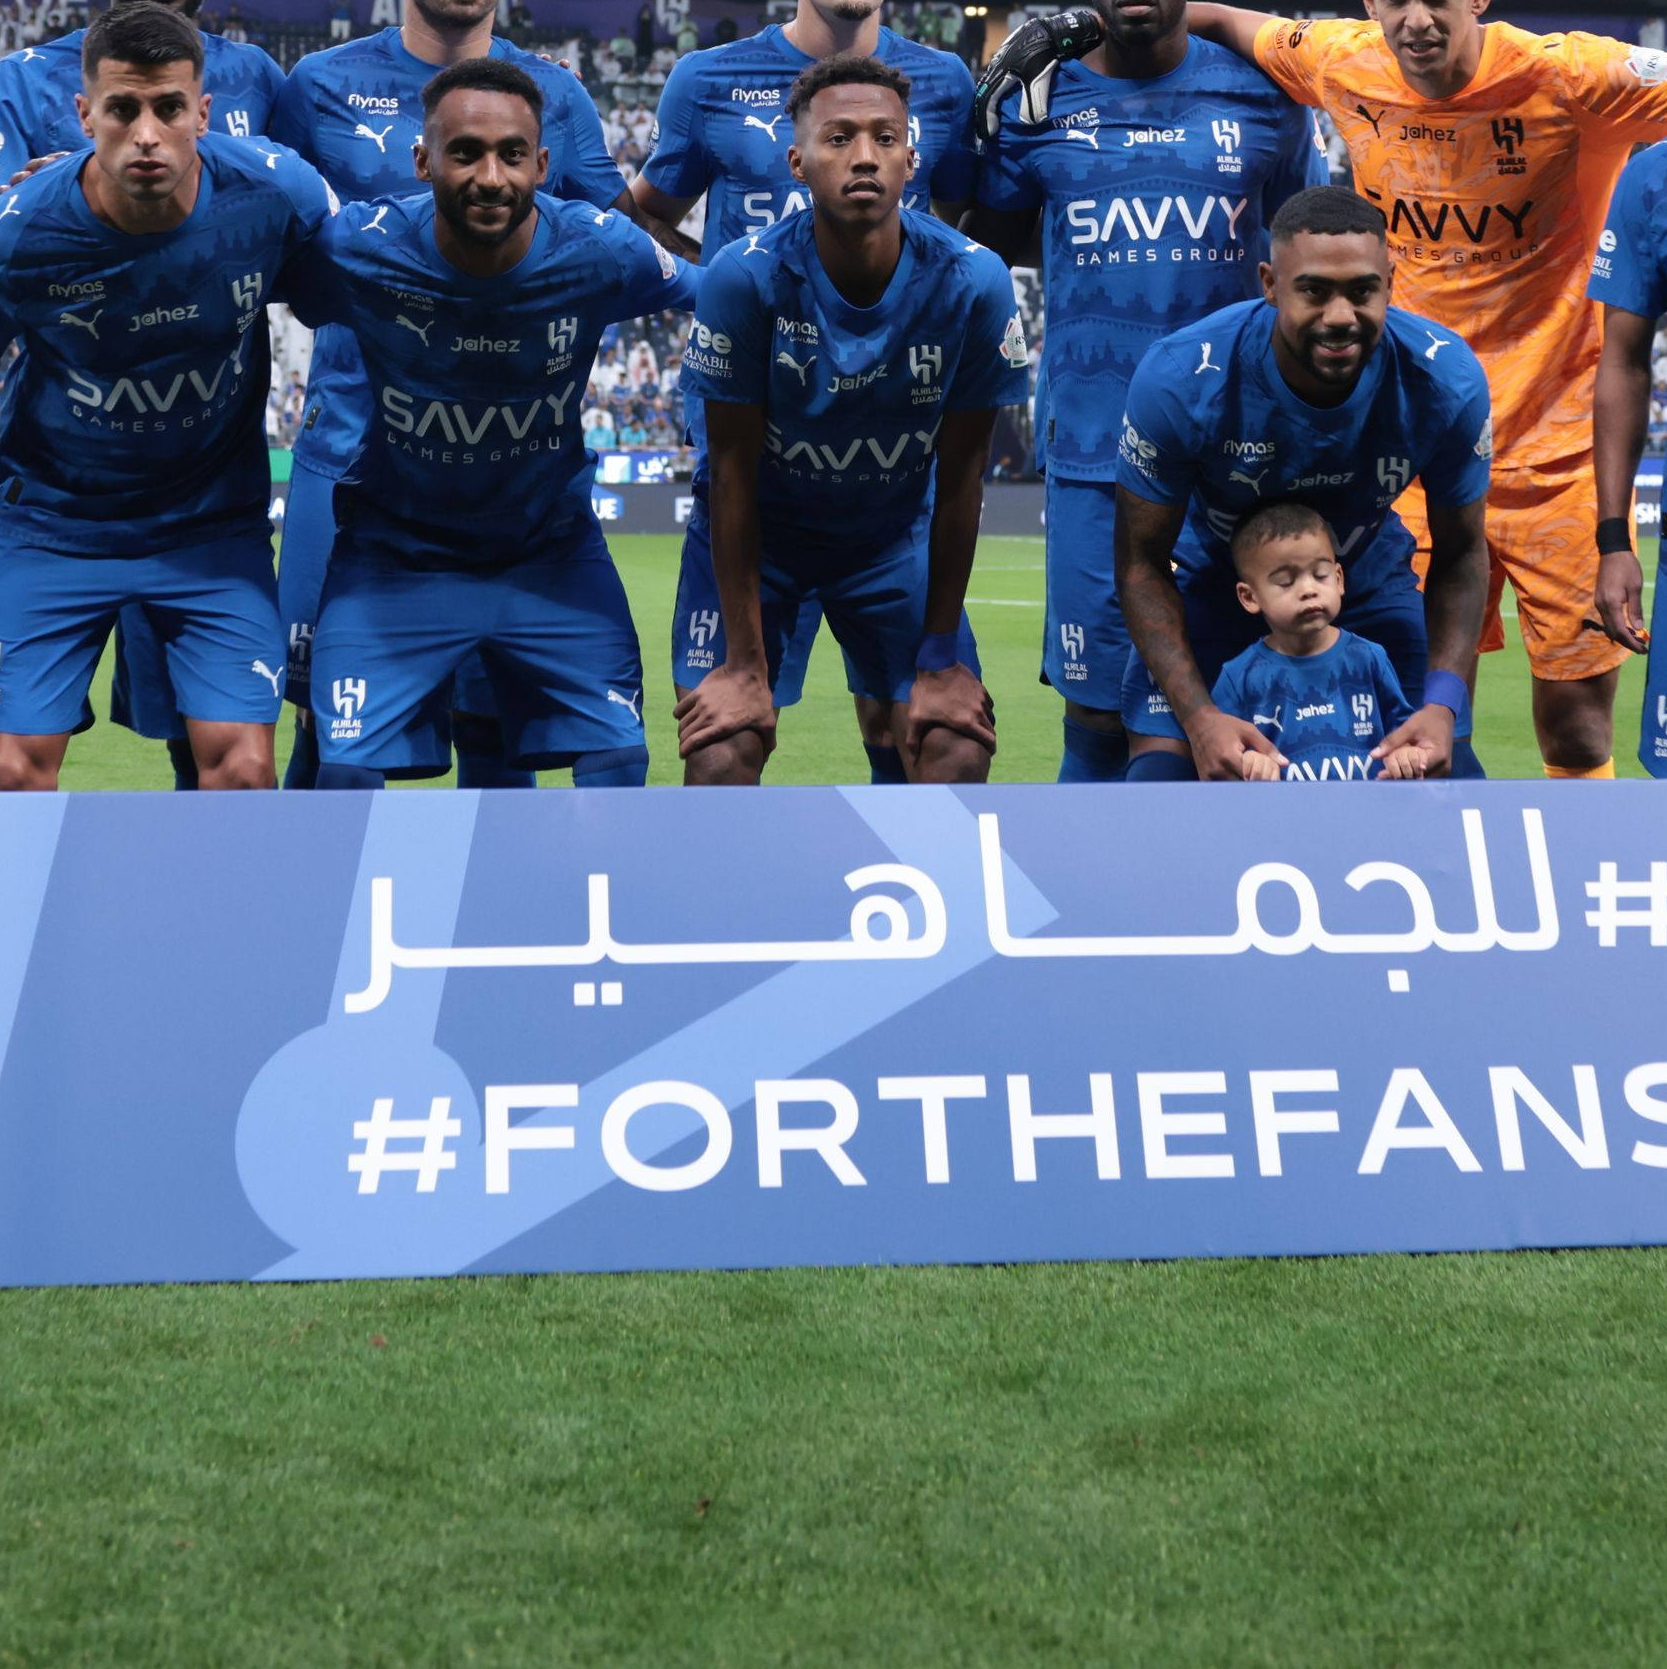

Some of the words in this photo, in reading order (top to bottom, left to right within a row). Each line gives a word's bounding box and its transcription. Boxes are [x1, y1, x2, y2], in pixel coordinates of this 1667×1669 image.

[348, 94, 399, 109] flynas
[732, 88, 780, 103] flynas
[1053, 107, 1099, 129] flynas
[1216, 155, 1243, 165] ALHILAL
[1067, 195, 1248, 245] SAVVY
[1077, 249, 1157, 266] GAMES
[1171, 247, 1245, 262] GROUP
[1454, 244, 1538, 263] GROUP
[48, 280, 105, 298] flynas
[688, 317, 732, 354] ree
[777, 316, 819, 337] flynas
[66, 335, 244, 414] SAVVY
[911, 386, 942, 397] ALHILAL
[72, 403, 166, 433] GAMES
[382, 381, 576, 445] SAVVY
[387, 431, 475, 464] GAMES
[766, 417, 942, 470] SAVVY
[1224, 439, 1276, 457] flynas
[687, 648, 714, 660] ALHILAL
[331, 719, 363, 730] ALHILAL
[331, 728, 361, 739] الهلال
